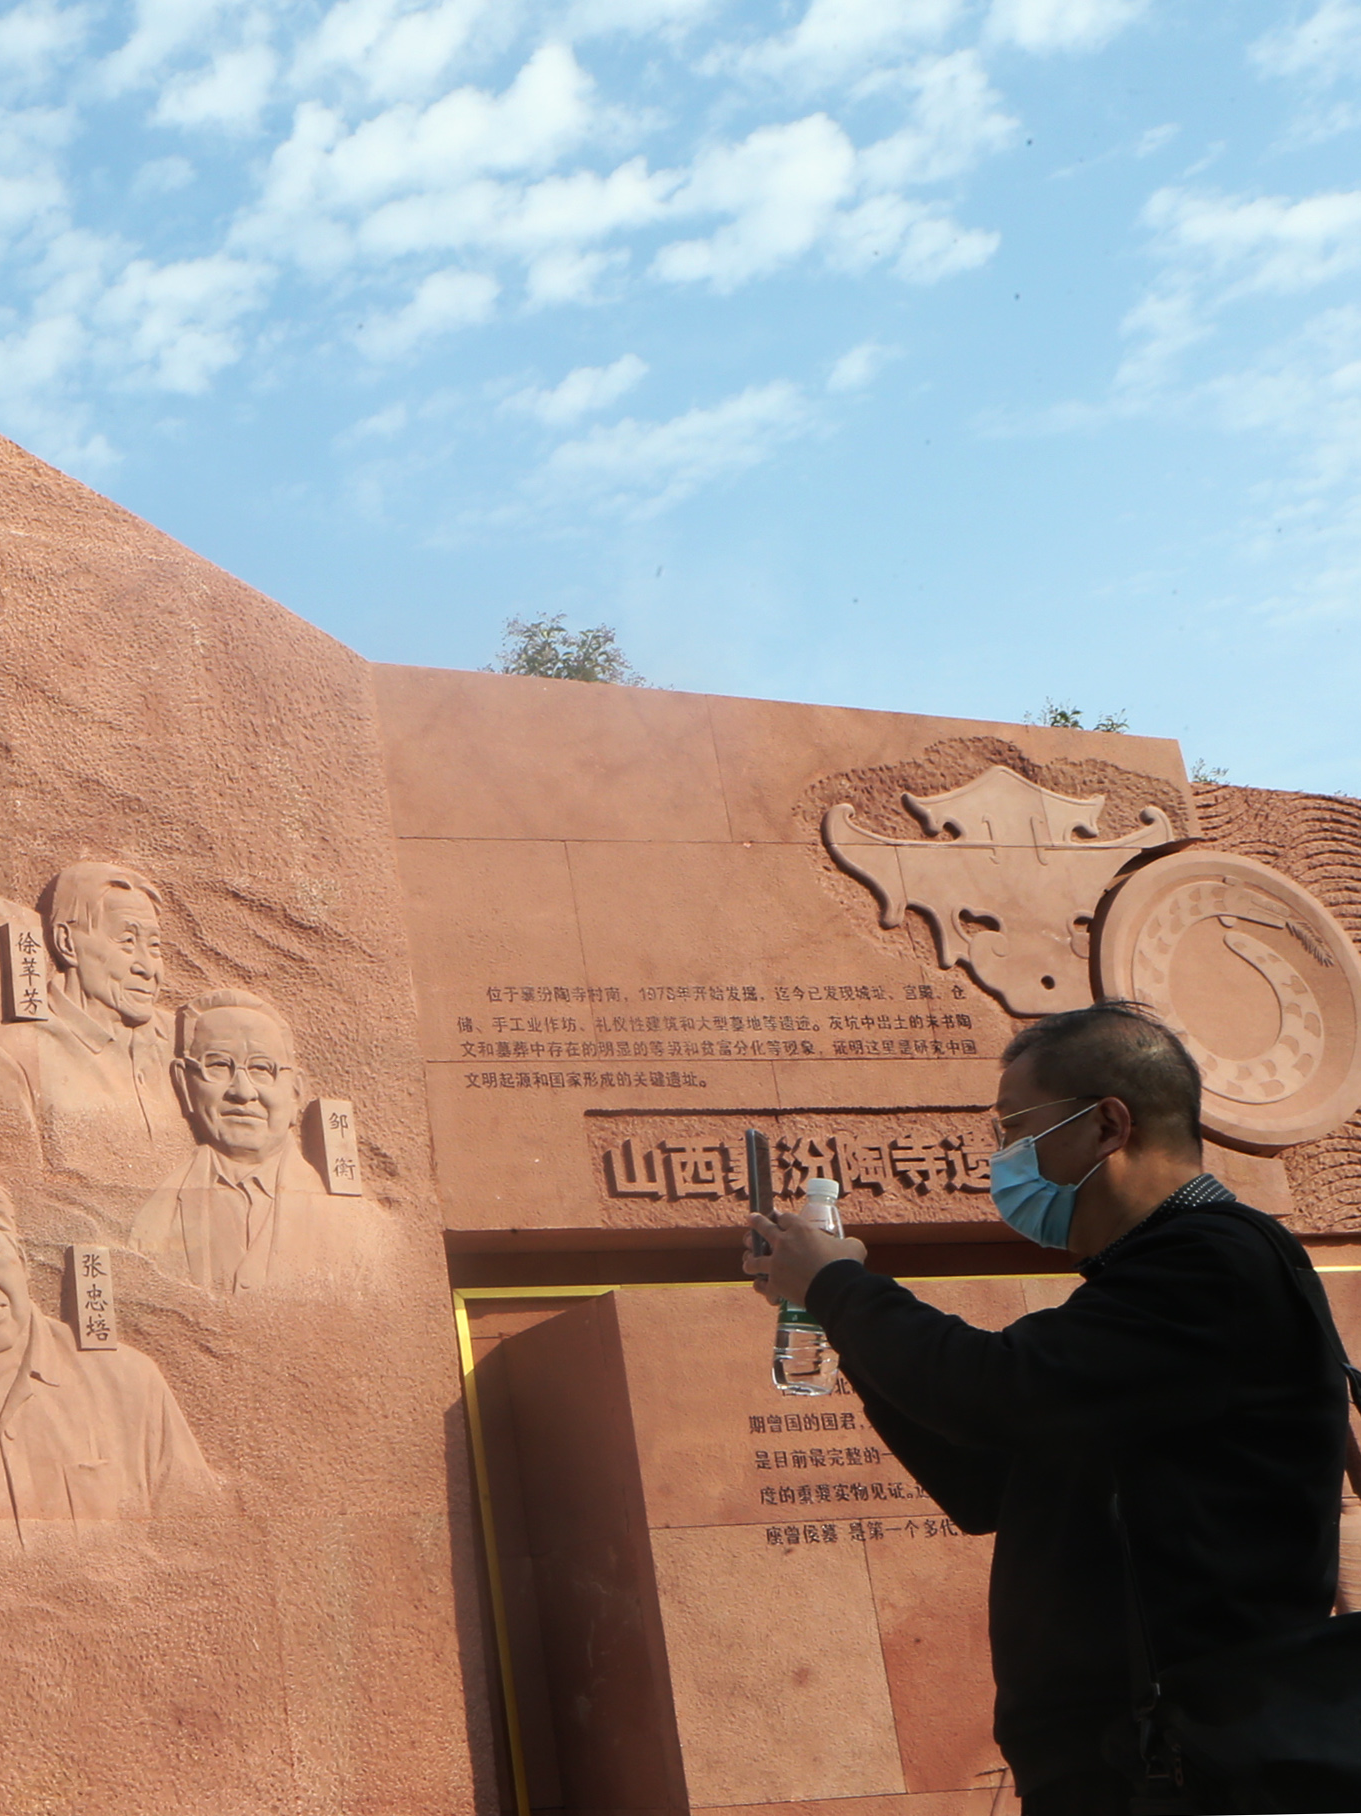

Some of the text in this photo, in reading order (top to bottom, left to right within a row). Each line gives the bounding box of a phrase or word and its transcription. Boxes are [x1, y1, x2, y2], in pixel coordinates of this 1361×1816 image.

[15, 932, 43, 1015] 徐苹芳
[464, 1070, 707, 1089] 文明起源和国家形成的关键遗址。
[329, 1112, 356, 1180] 邹衡
[82, 1254, 111, 1341] 张忠培
[749, 1412, 872, 1434] 期曾国的国君，
